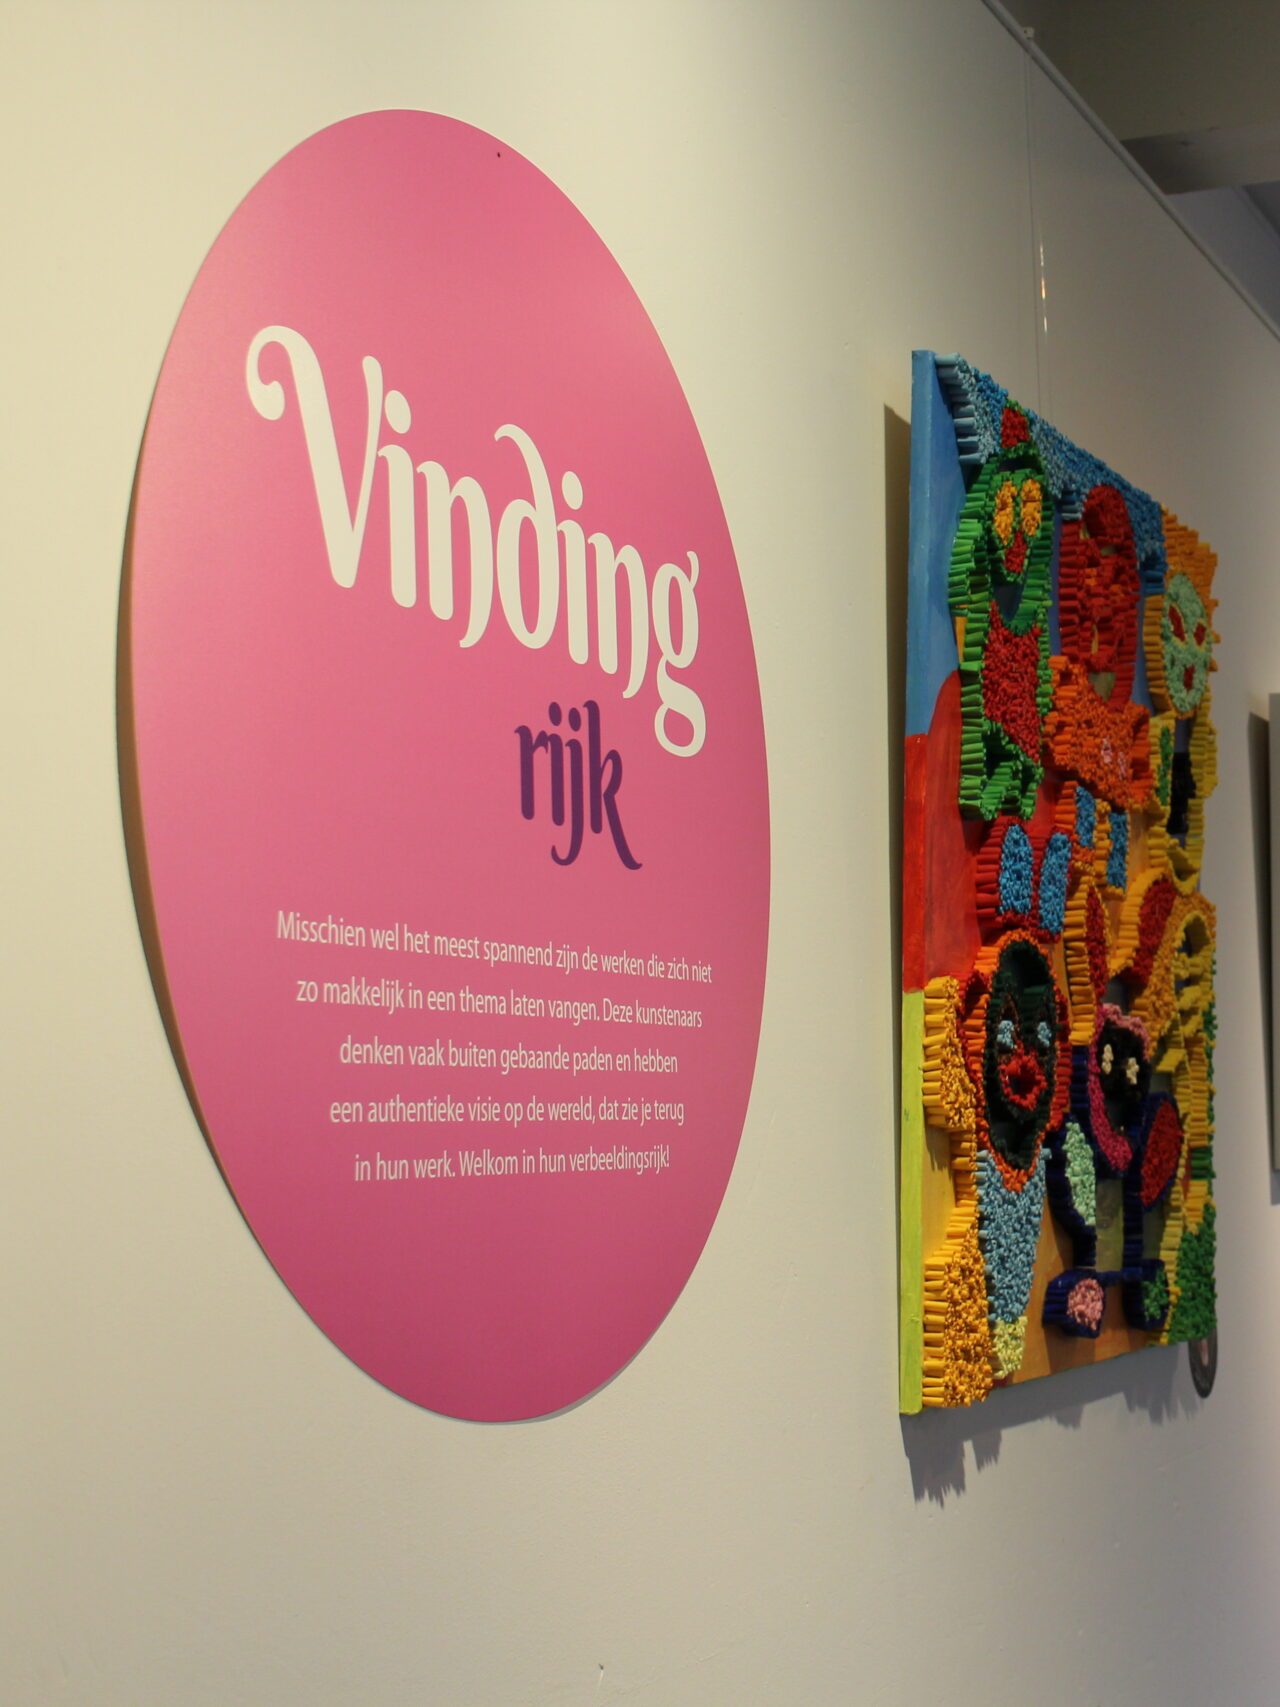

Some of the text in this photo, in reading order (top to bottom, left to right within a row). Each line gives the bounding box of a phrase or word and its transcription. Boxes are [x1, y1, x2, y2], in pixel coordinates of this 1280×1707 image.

[246, 325, 706, 757] Vinding
[514, 700, 643, 870] rijk
[277, 910, 712, 983] Misschien wel het meest spannend zijn de werken die zich niet
[296, 976, 702, 1027] zo makkelijk in een thema laten vangen. Deze kunstenaars
[340, 1035, 678, 1076] denken vaak buiten gebaande paden en hebben
[330, 1094, 684, 1128] een authentieke visie op de wereld, dat zie je terug
[355, 1144, 670, 1181] in hun werk. Welkom in hun verbeeldingsrijk!
